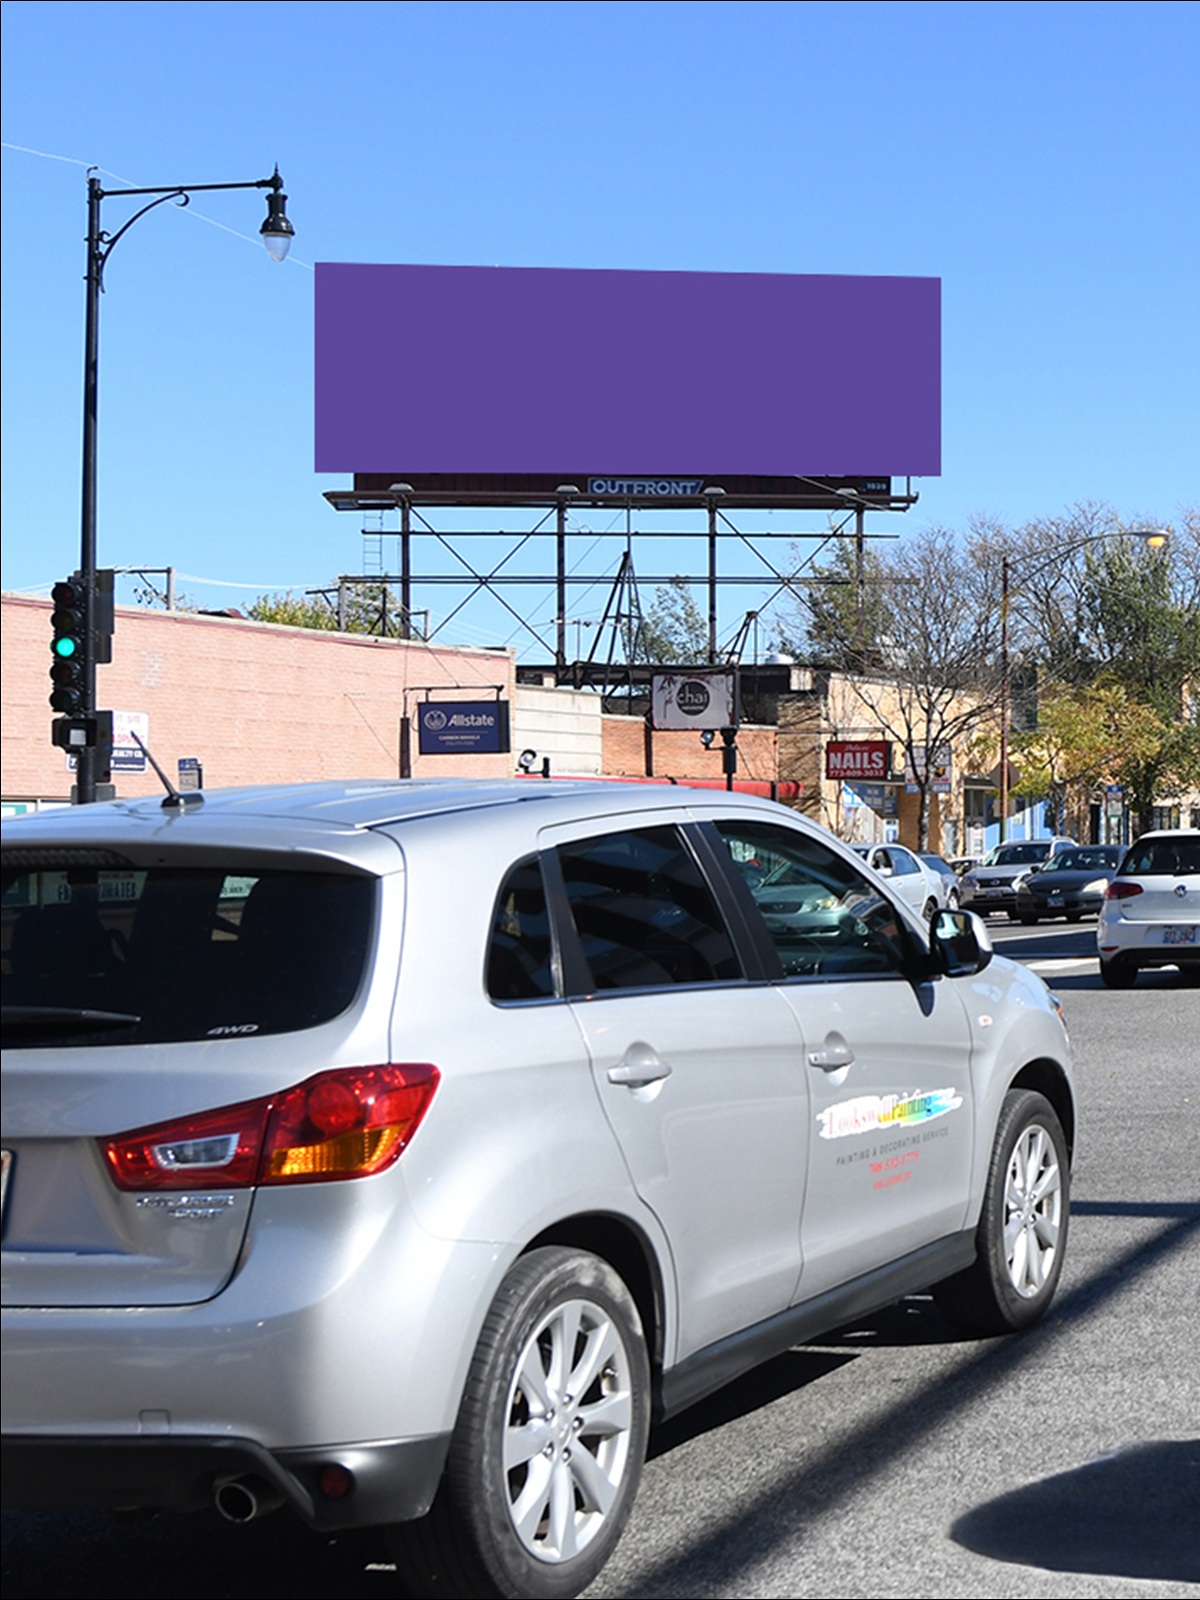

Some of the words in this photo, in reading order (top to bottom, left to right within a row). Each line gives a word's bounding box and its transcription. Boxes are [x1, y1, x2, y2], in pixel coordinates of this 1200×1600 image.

[677, 685, 708, 704] chai
[448, 714, 495, 727] Allstate
[829, 751, 884, 769] NAILS
[207, 1023, 260, 1035] 4WD
